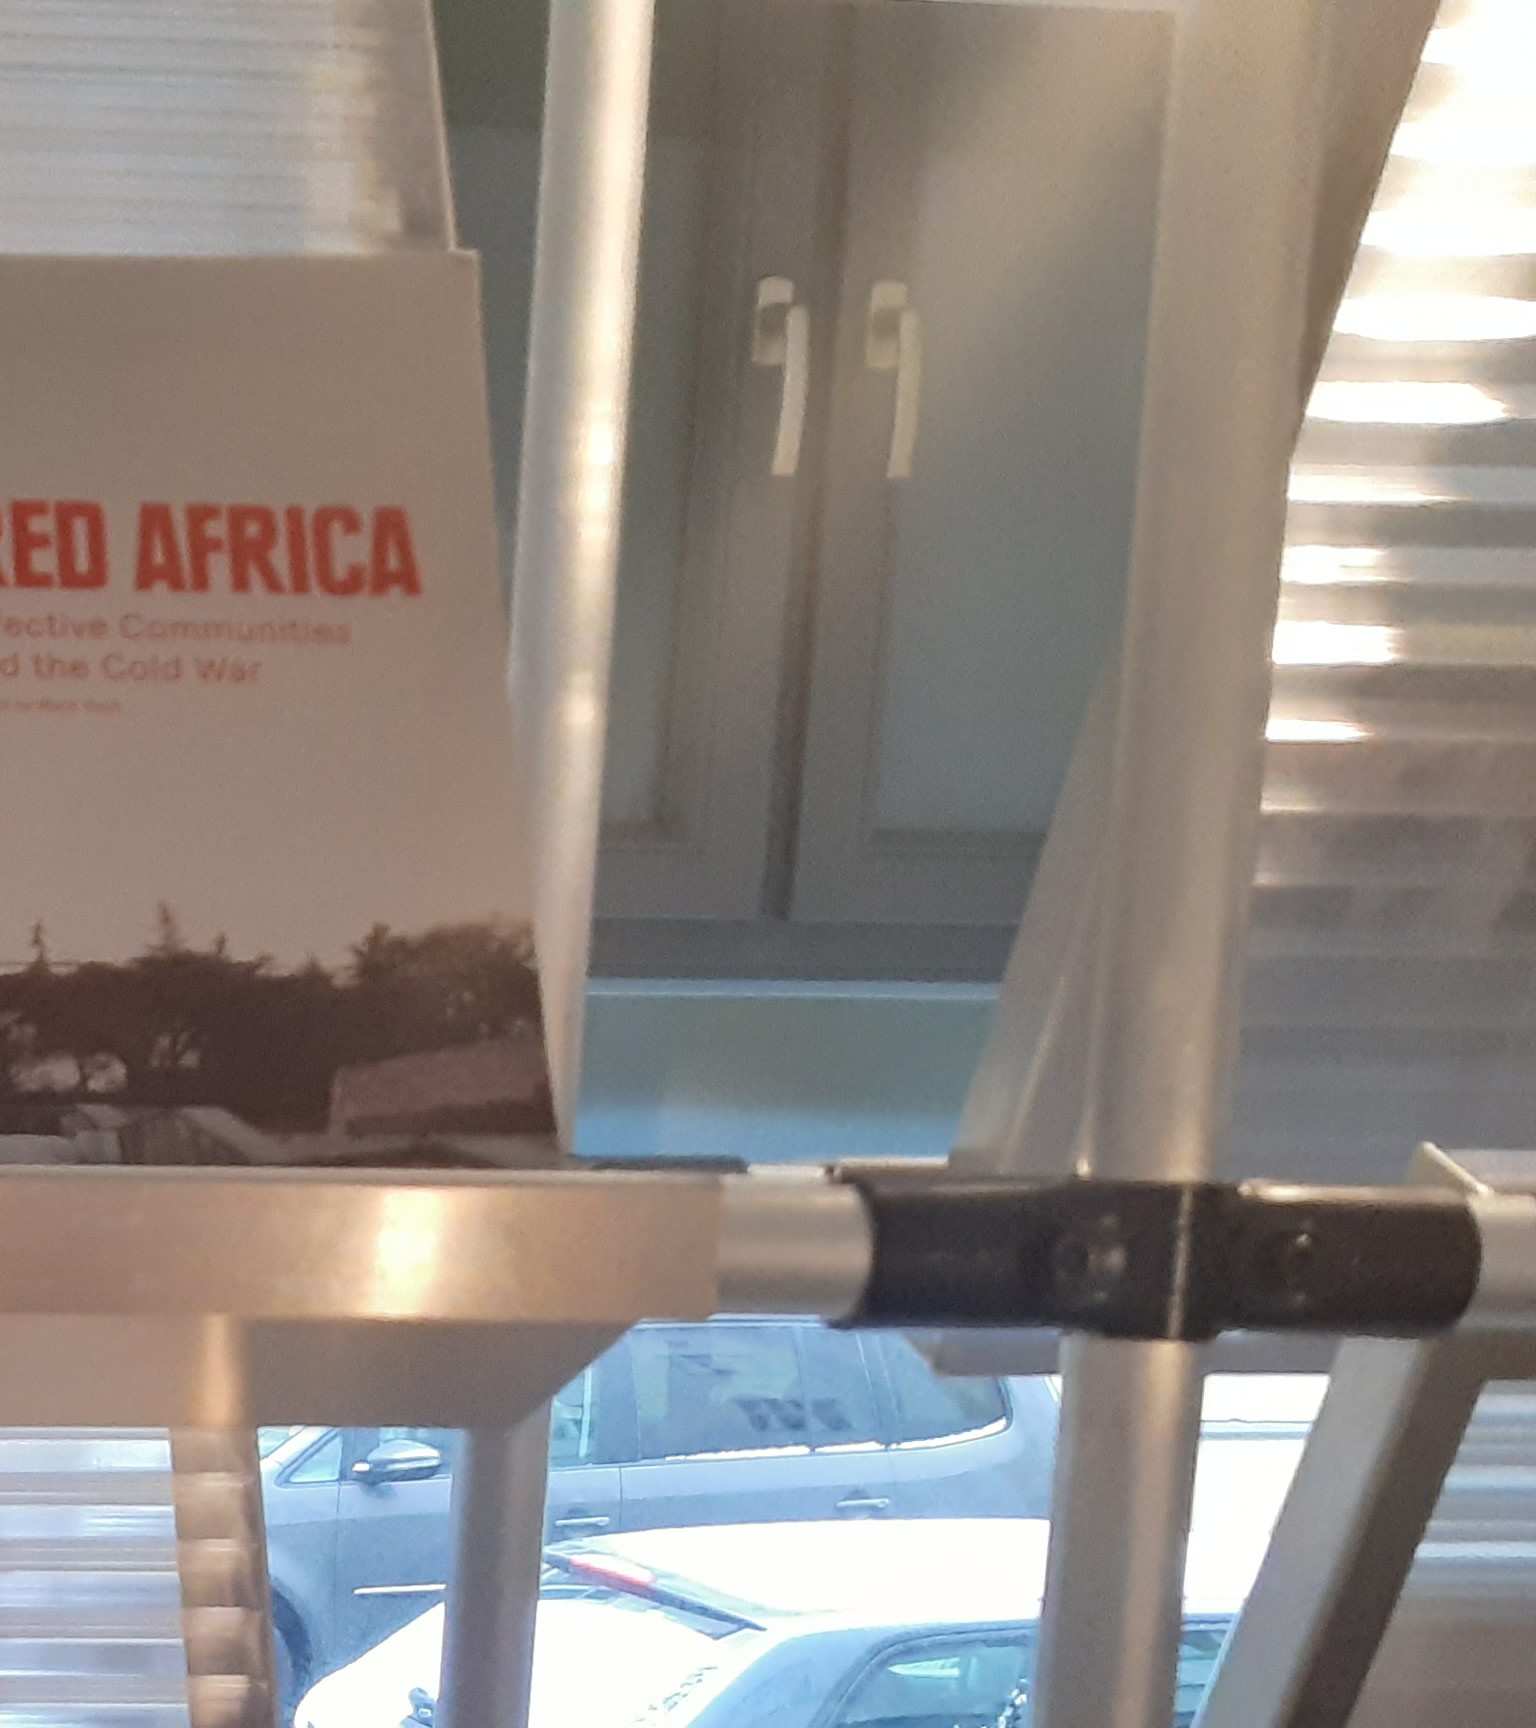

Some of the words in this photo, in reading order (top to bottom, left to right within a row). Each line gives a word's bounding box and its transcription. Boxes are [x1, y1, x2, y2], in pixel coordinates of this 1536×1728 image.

[135, 502, 422, 598] AFRICA
[119, 612, 351, 646] Communities
[31, 652, 92, 681] the
[100, 652, 184, 683] Cold
[194, 657, 262, 684] War
